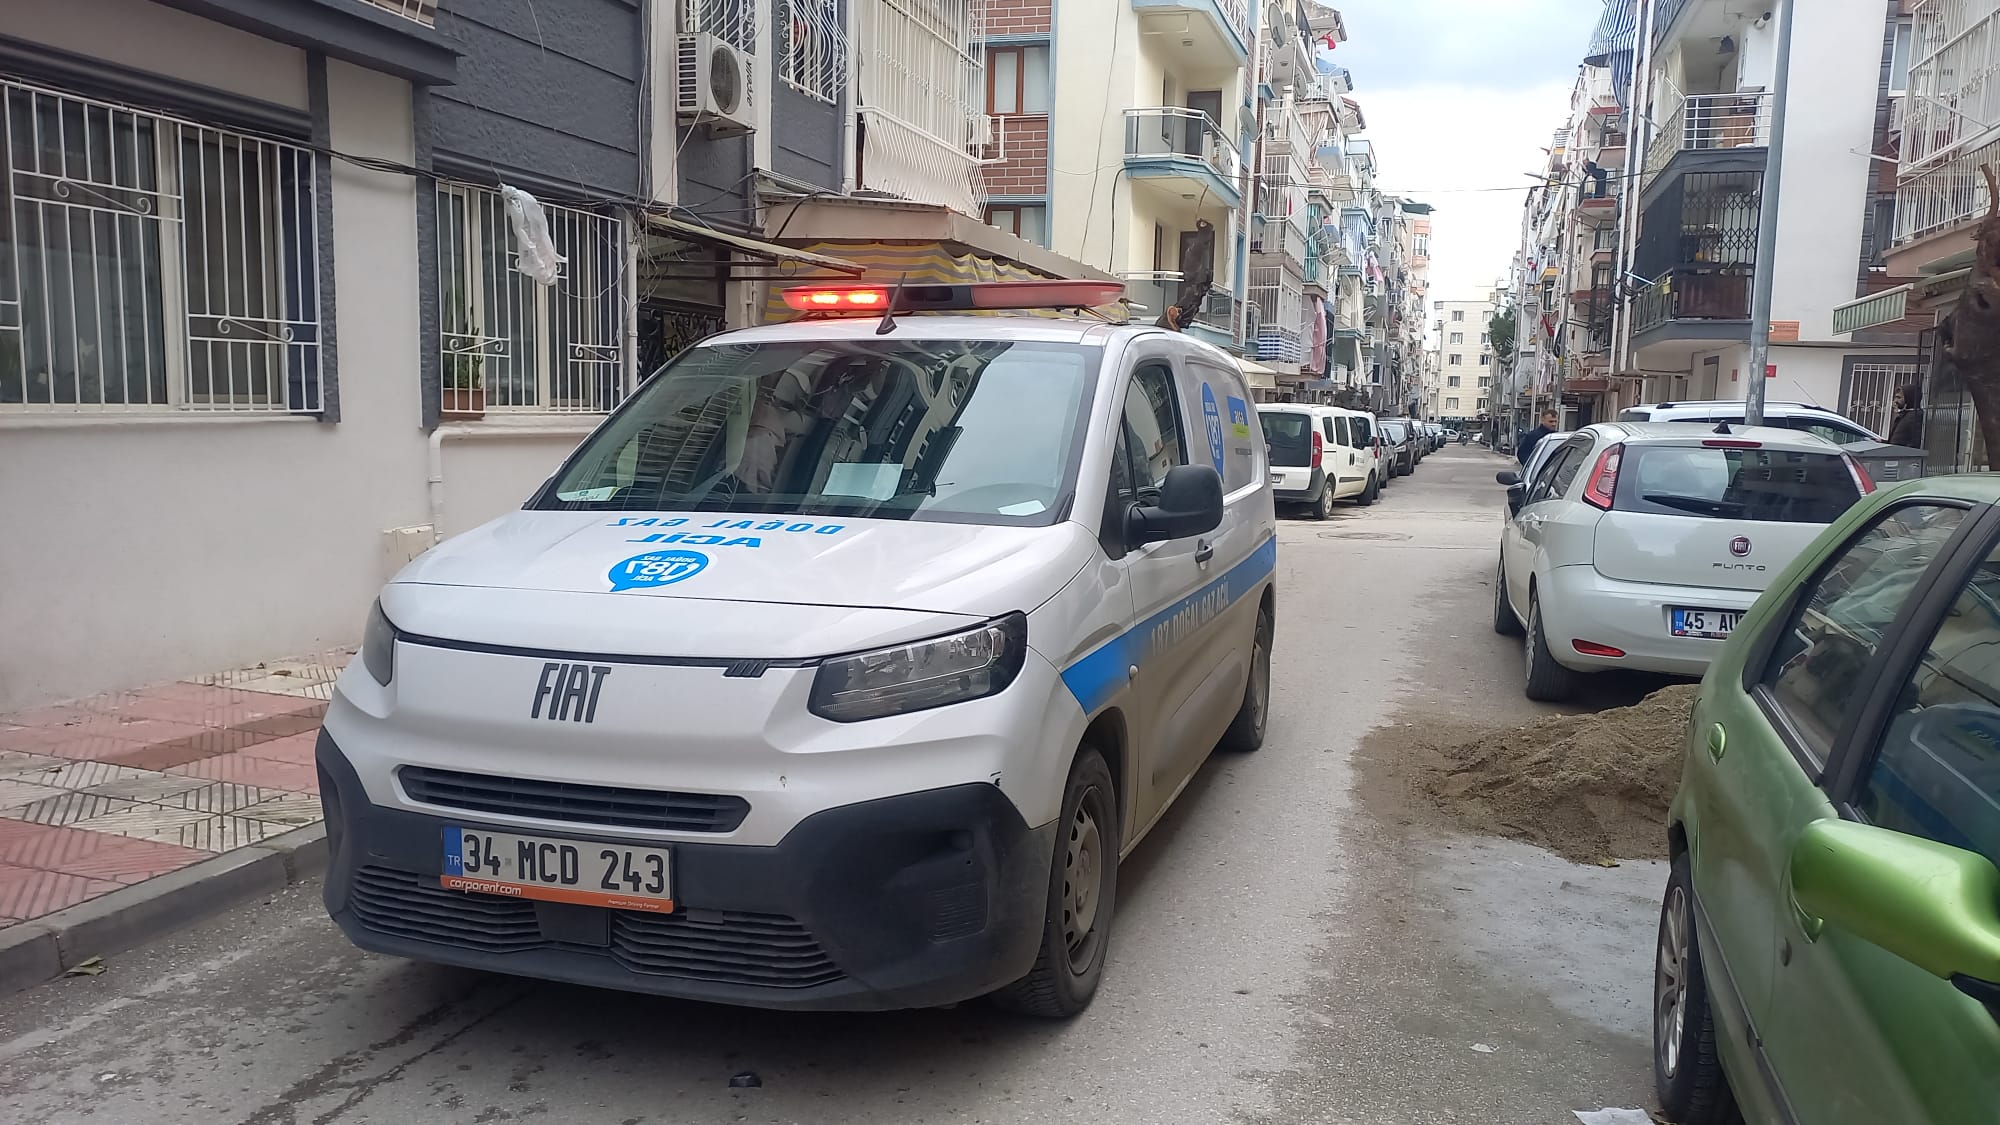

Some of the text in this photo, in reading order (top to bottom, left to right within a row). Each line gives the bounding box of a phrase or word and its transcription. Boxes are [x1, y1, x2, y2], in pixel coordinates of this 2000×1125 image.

[745, 58, 753, 107] arçelik
[1712, 562, 1766, 571] PUNTO
[1685, 612, 1704, 629] 45
[1719, 614, 1744, 631] AU
[531, 662, 612, 723] FIAT
[447, 834, 664, 894] TR 34 MCD 243
